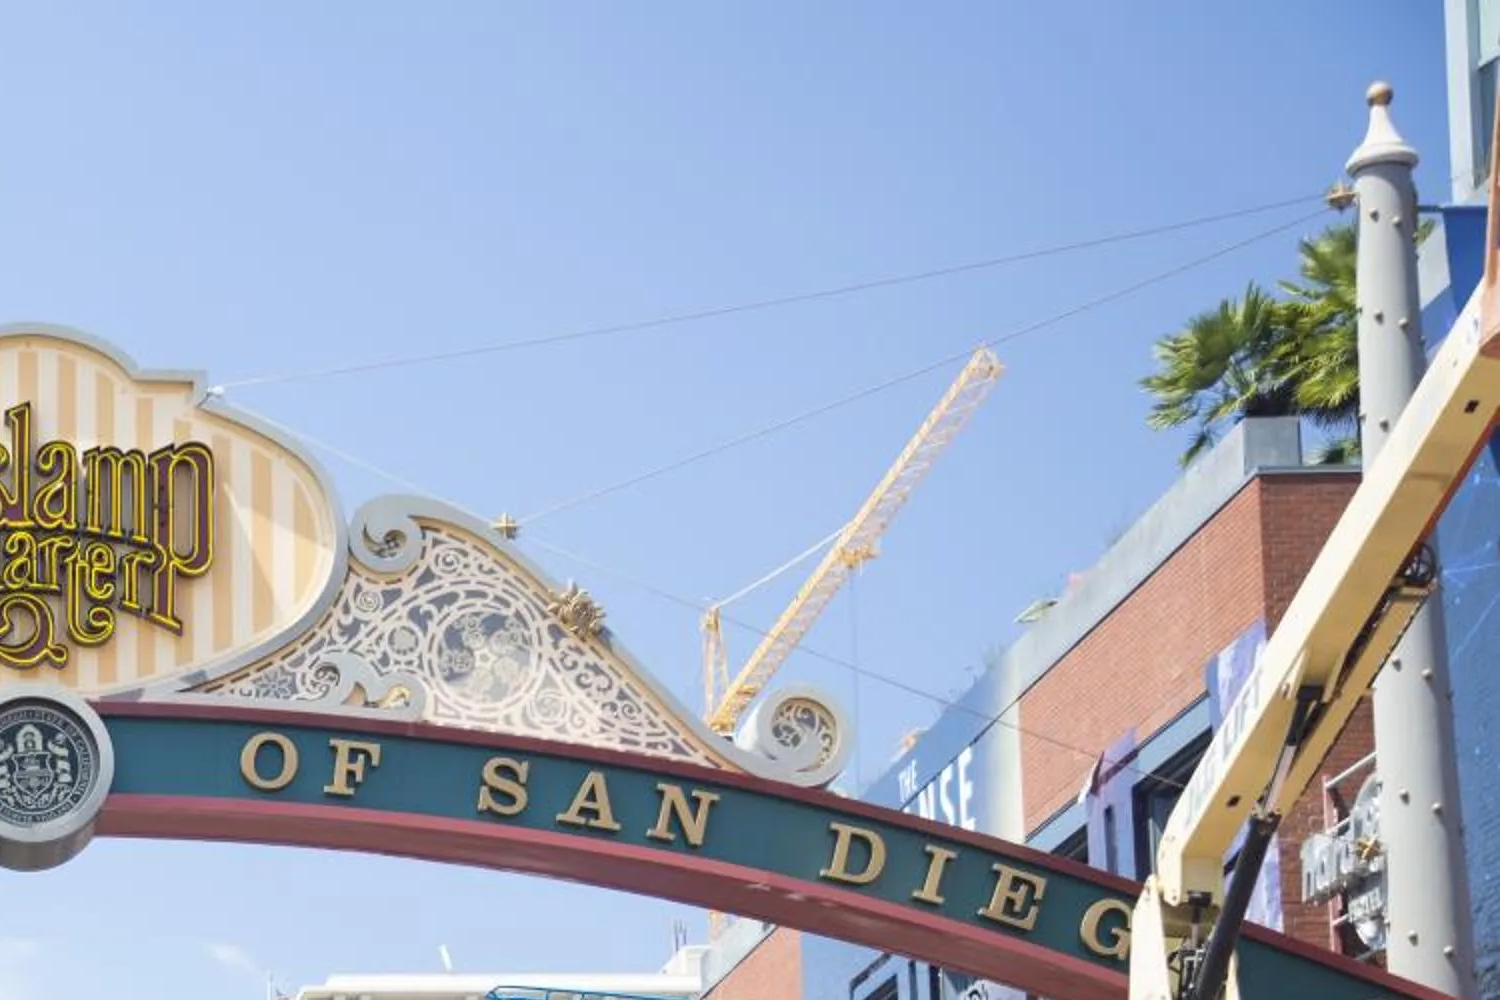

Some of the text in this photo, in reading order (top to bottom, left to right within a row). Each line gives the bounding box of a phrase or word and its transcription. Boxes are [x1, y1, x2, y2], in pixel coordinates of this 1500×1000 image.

[239, 732, 382, 797] OF
[476, 756, 721, 847] SAN
[819, 821, 1135, 962] DIEG
